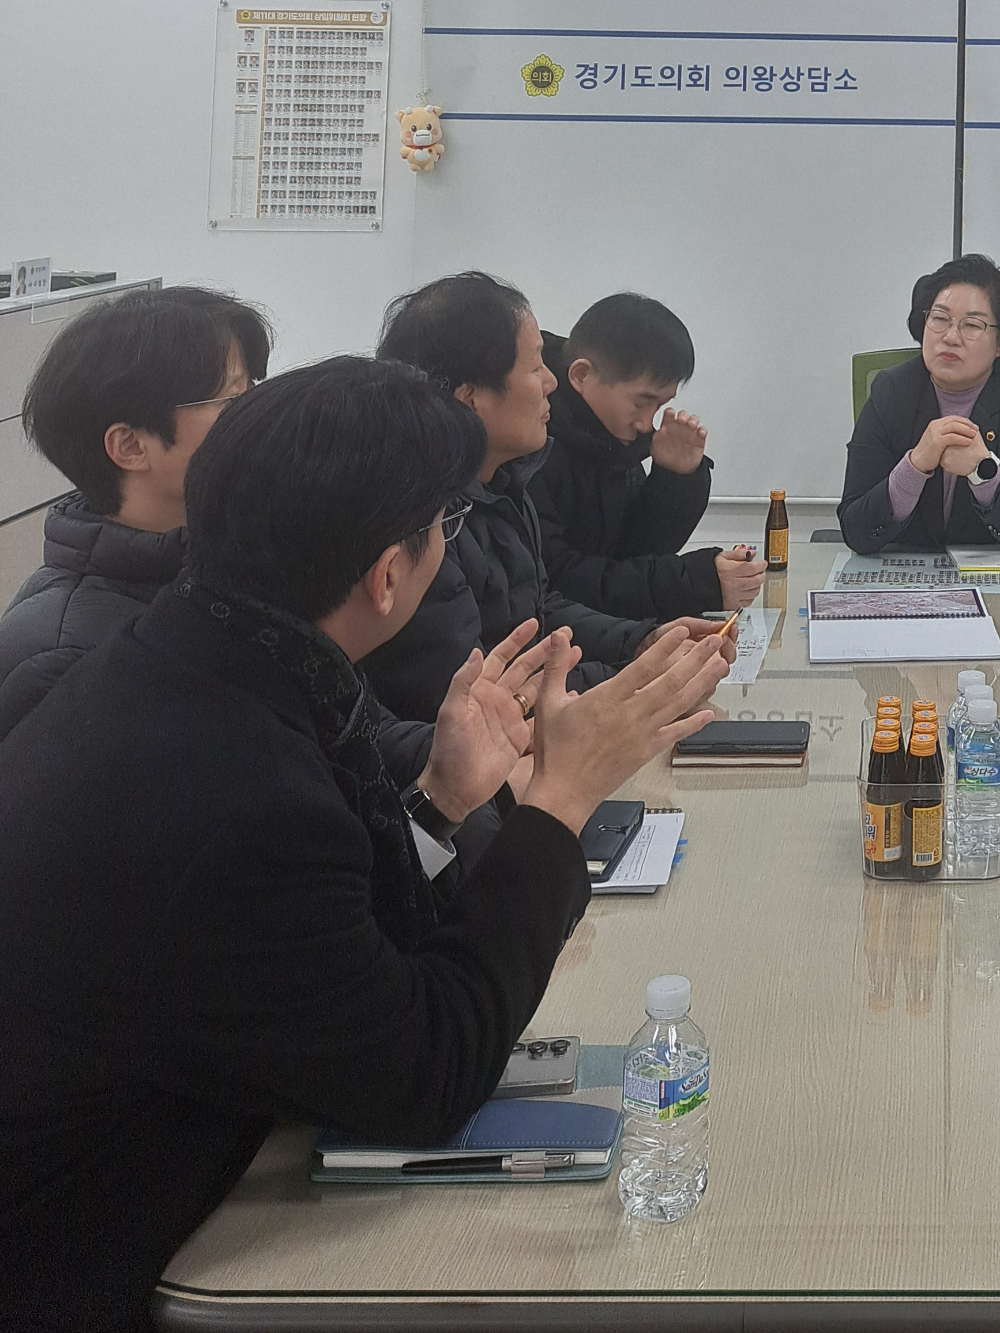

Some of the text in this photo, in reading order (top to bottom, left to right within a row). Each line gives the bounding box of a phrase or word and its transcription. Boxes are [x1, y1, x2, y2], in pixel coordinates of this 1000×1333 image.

[252, 12, 276, 20] 제11대
[277, 12, 313, 21] 경기도의회
[532, 71, 552, 82] 의회
[574, 62, 859, 93] 경기도의회 의왕상담소
